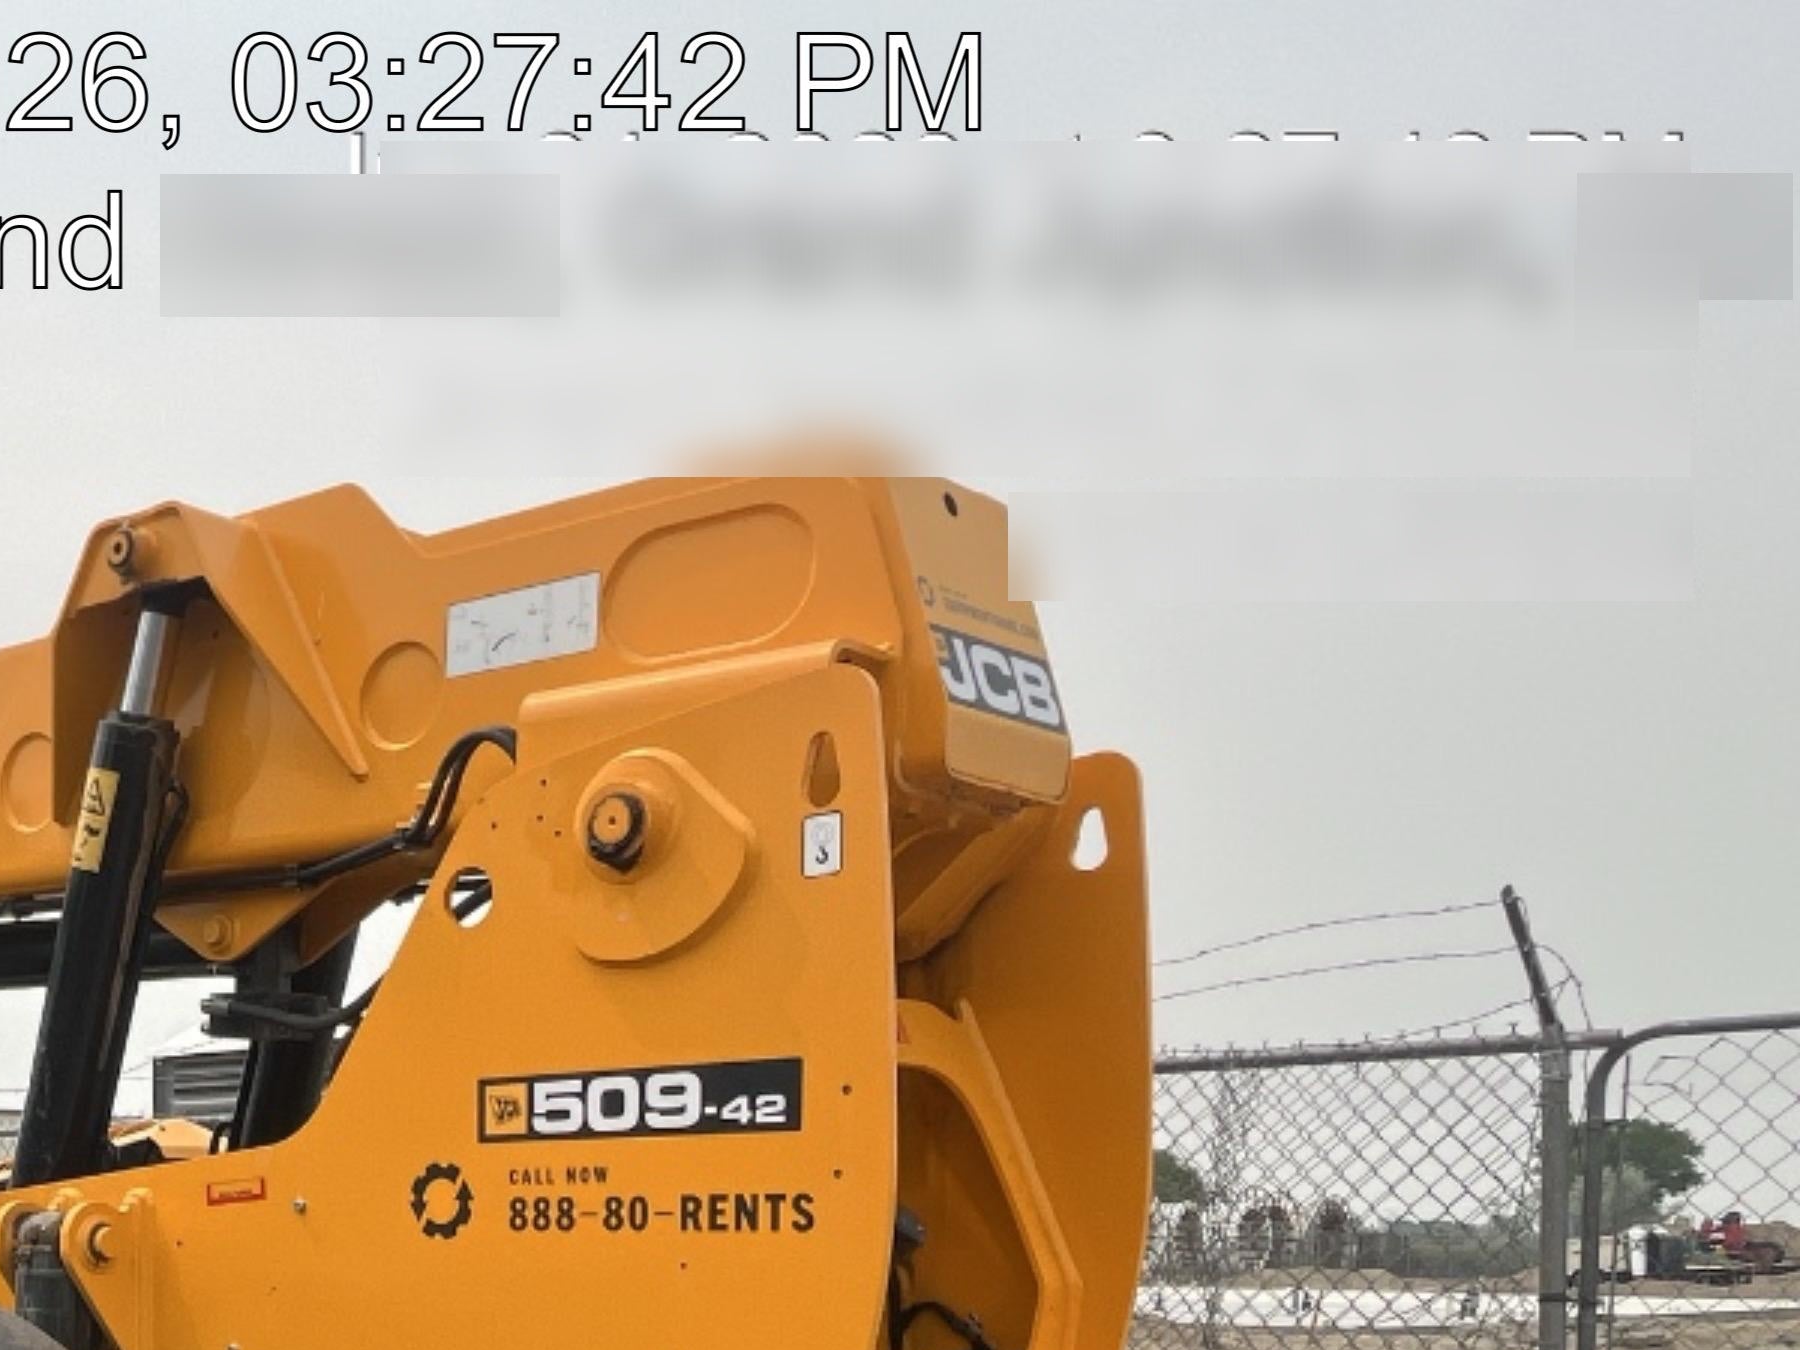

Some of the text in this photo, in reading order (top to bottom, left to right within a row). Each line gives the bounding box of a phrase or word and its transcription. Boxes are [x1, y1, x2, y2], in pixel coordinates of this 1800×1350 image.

[940, 636, 1062, 727] JCB
[531, 1071, 788, 1134] 509-42
[509, 1166, 608, 1186] CALL NOW
[508, 1193, 815, 1232] 888-80-RENTS
